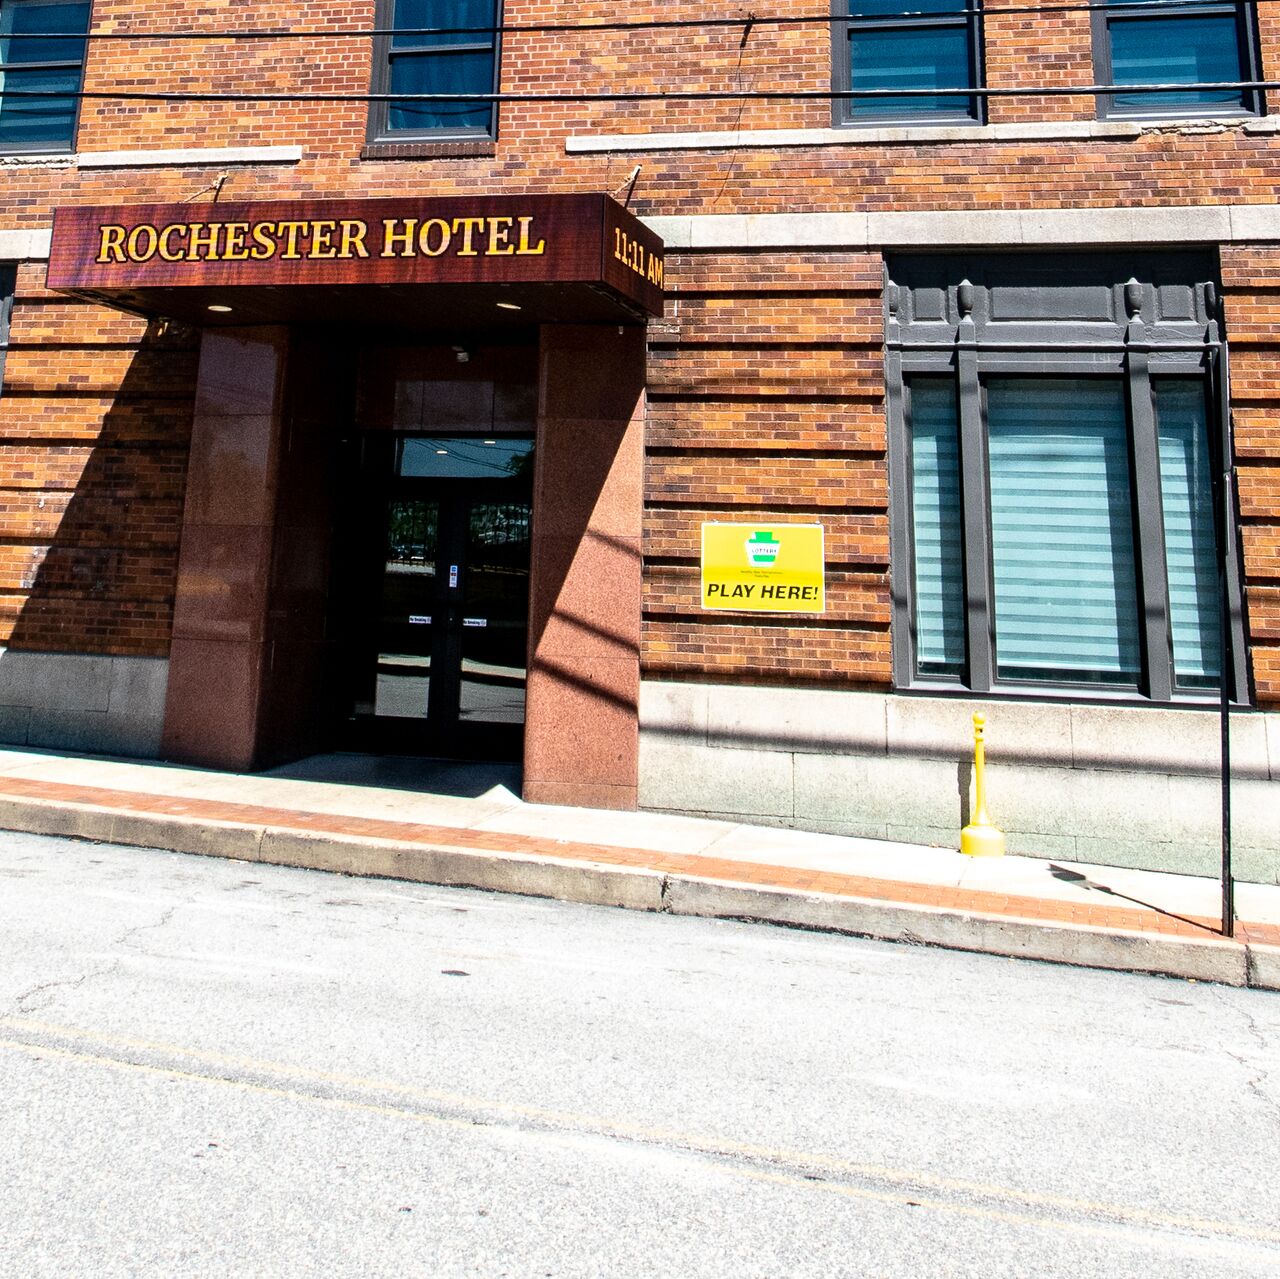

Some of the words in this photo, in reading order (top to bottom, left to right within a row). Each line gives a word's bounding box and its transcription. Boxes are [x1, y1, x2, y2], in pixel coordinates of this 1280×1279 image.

[96, 218, 369, 263] ROCHESTER
[381, 216, 545, 258] HOTEL
[614, 227, 645, 277] 11:11
[647, 252, 663, 289] AM
[707, 583, 755, 598] PLAY
[760, 585, 818, 600] HERE!
